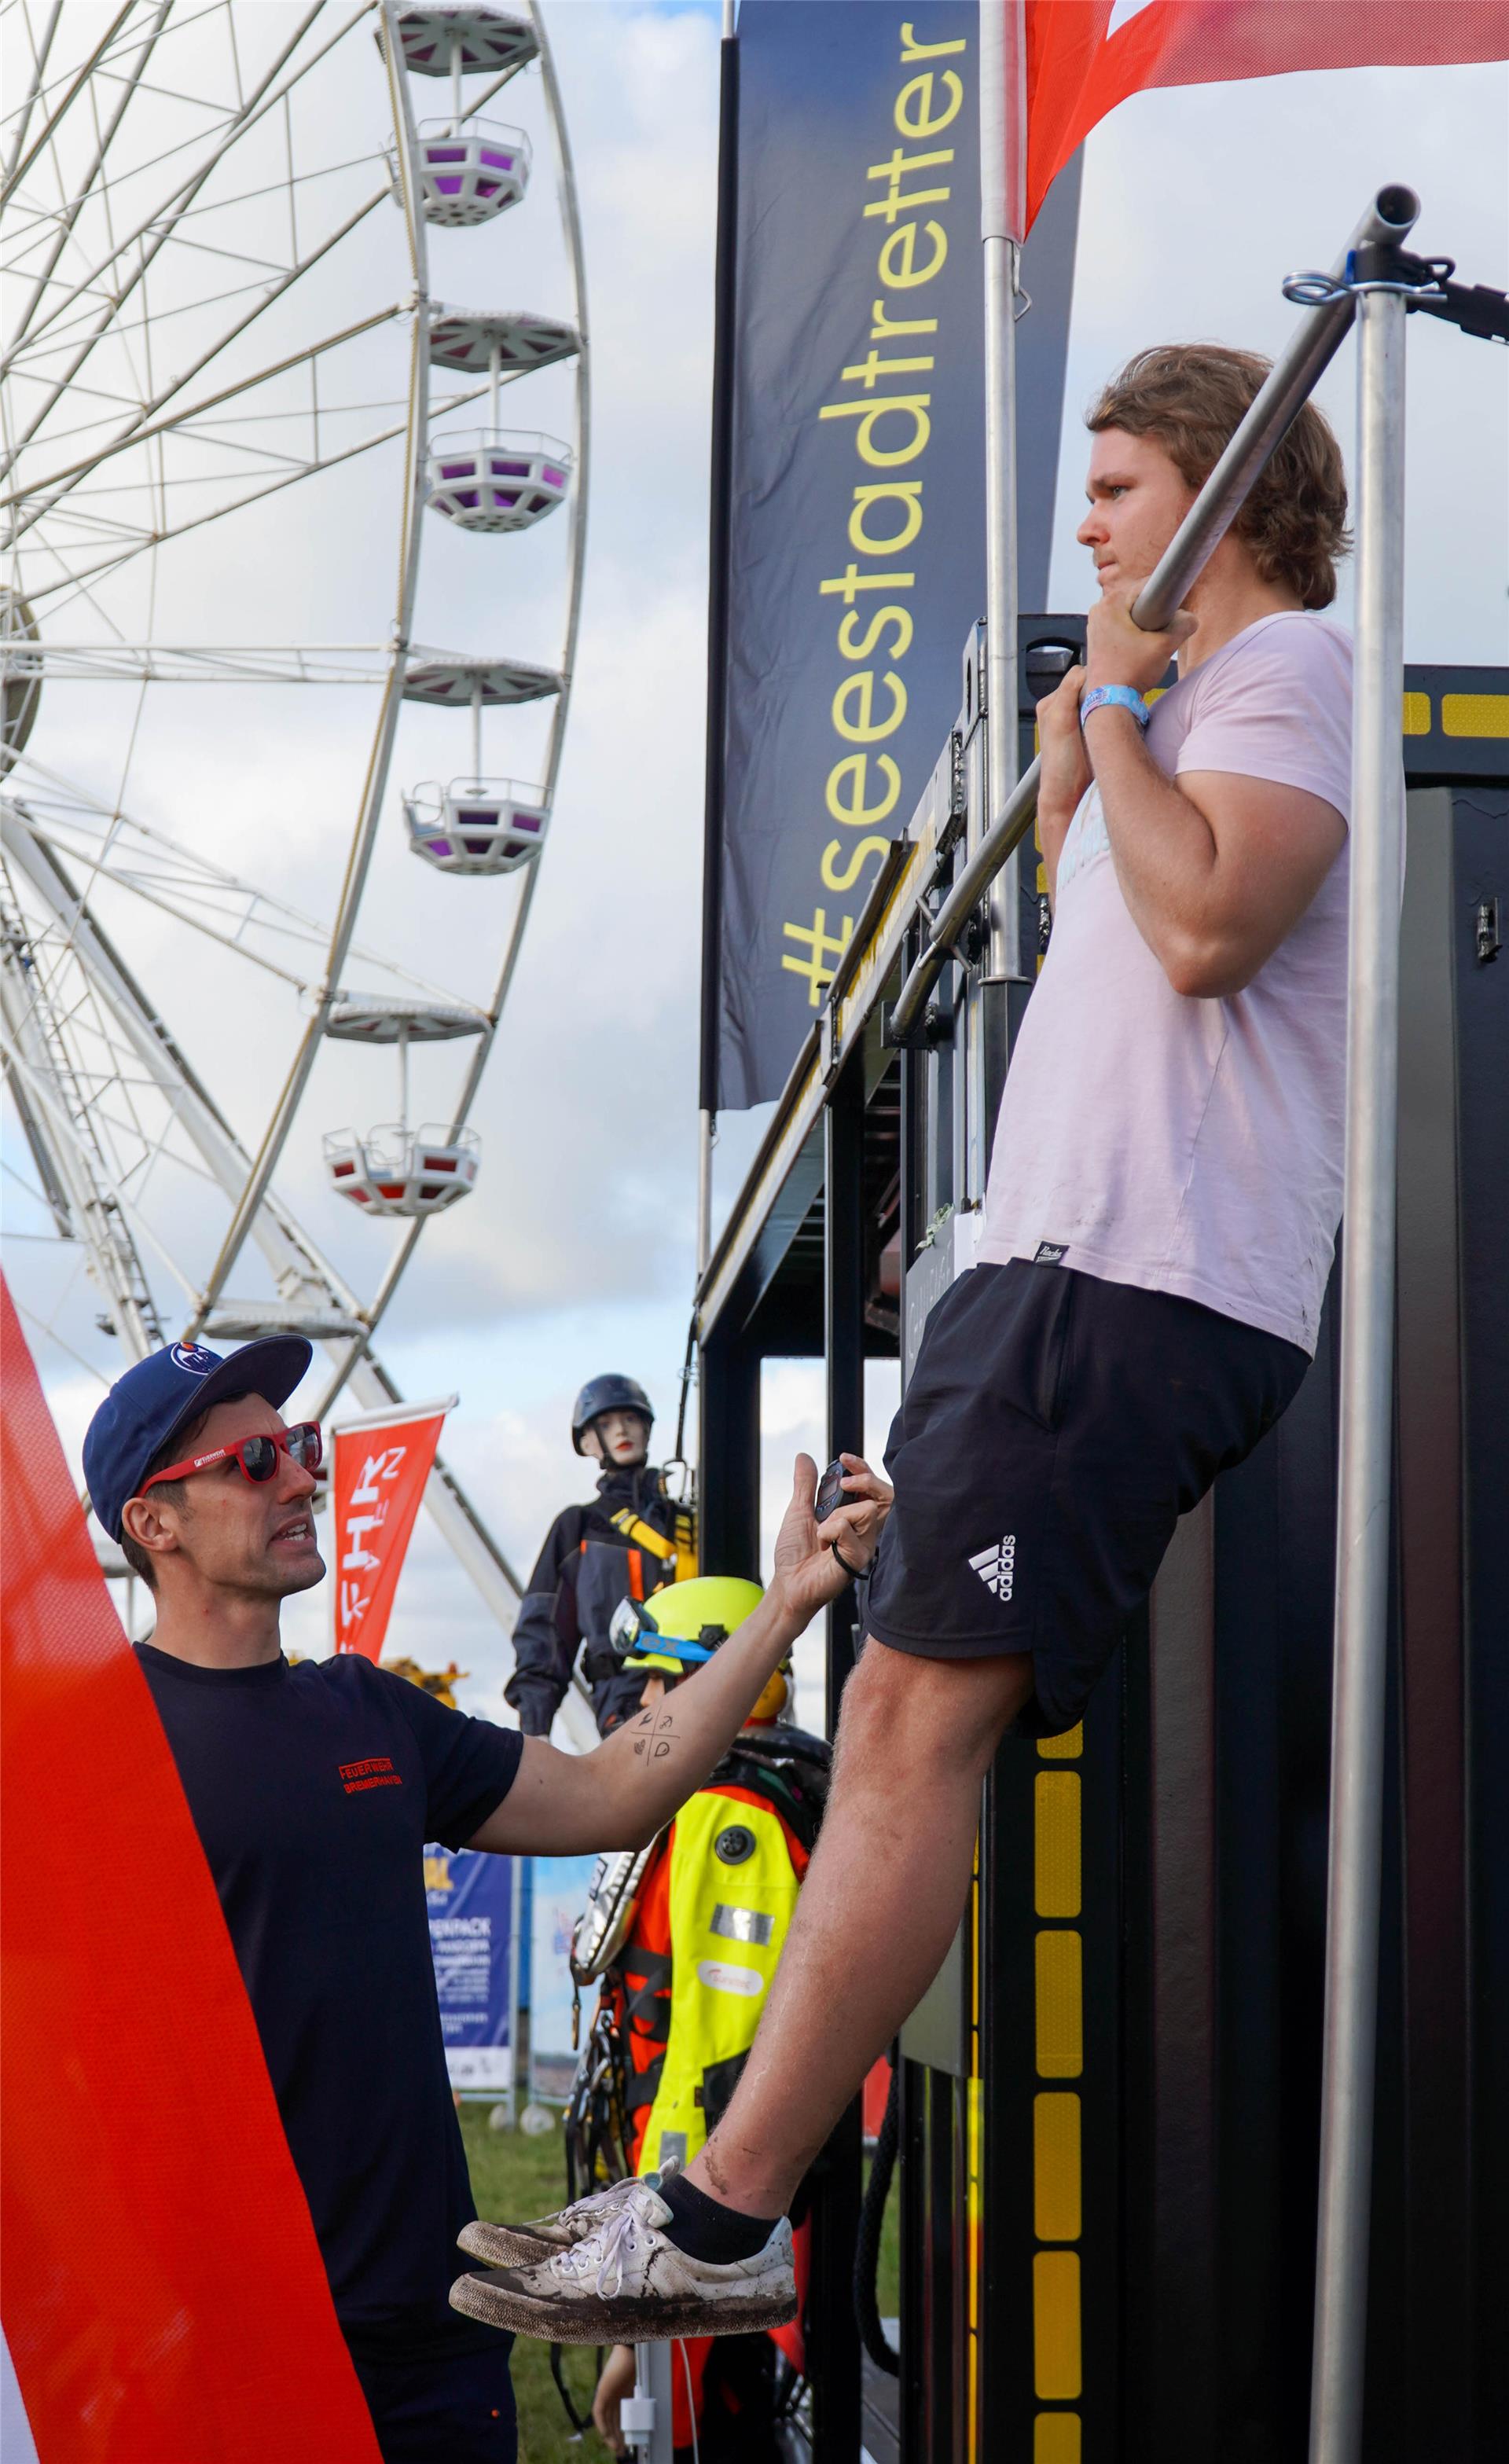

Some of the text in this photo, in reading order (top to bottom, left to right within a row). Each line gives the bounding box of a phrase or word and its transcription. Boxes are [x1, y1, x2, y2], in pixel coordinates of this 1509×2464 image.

[781, 23, 967, 1008] #seestadtretter
[997, 1534, 1016, 1602] adidas
[339, 1757, 395, 1779] FEUERWEHR
[343, 1774, 403, 1794] BREMERHAVEN
